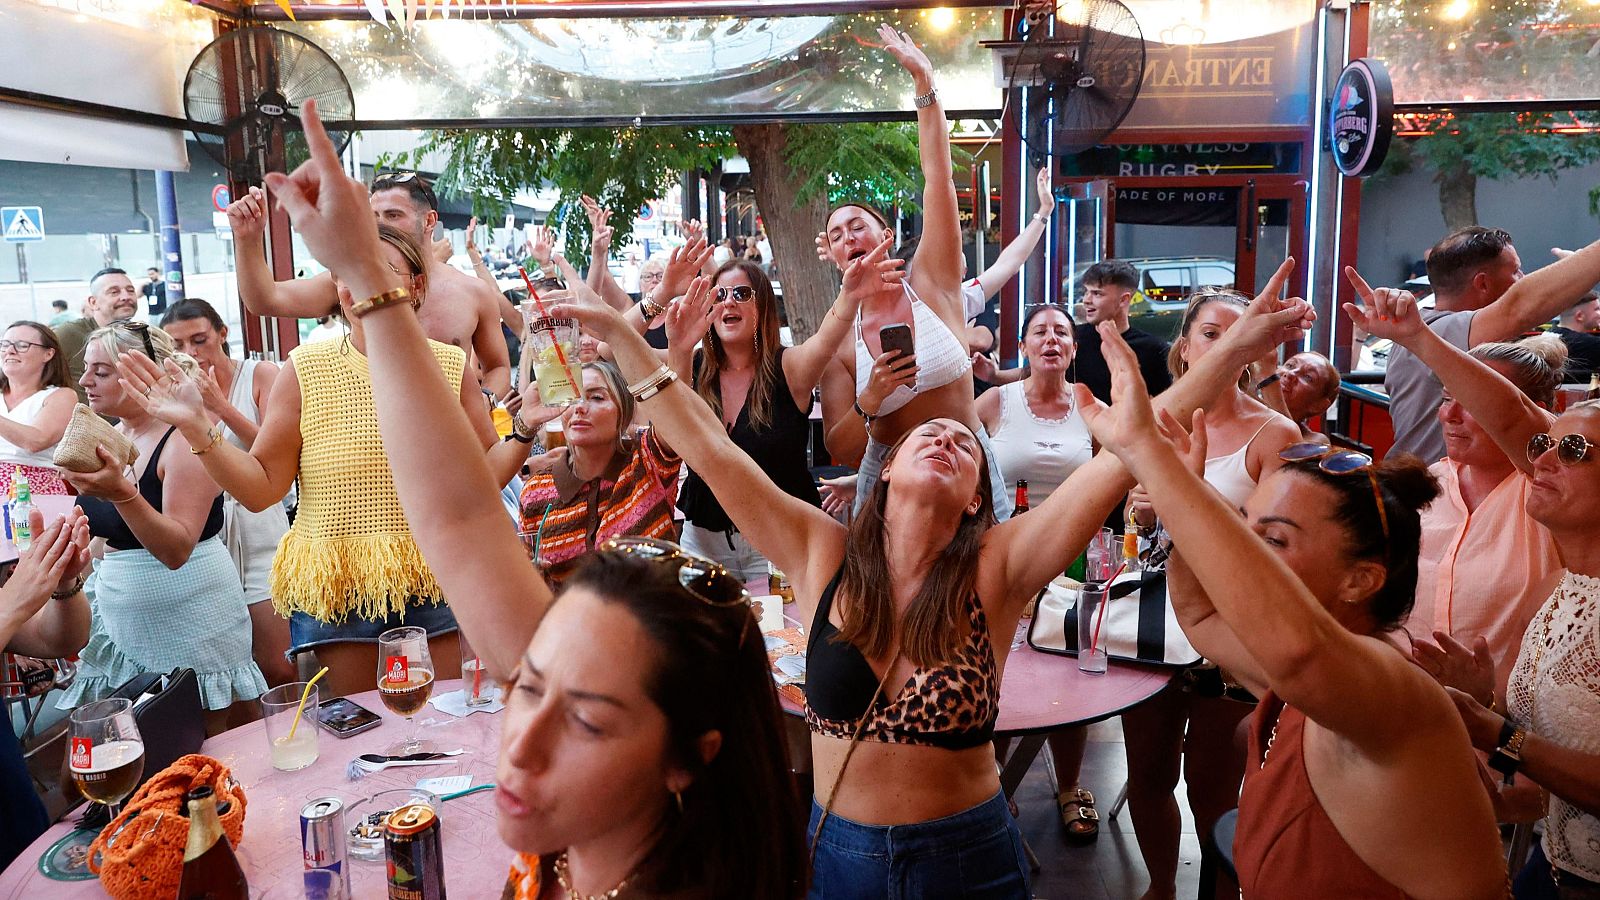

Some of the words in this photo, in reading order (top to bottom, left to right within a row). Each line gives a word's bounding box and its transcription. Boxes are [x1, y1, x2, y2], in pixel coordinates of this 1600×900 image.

[1119, 162, 1220, 177] RUGBY
[1119, 190, 1149, 201] ADE
[1157, 191, 1175, 201] OF
[1183, 191, 1225, 202] MORE
[529, 318, 573, 334] KOPPARBERG
[304, 850, 325, 862] Bull
